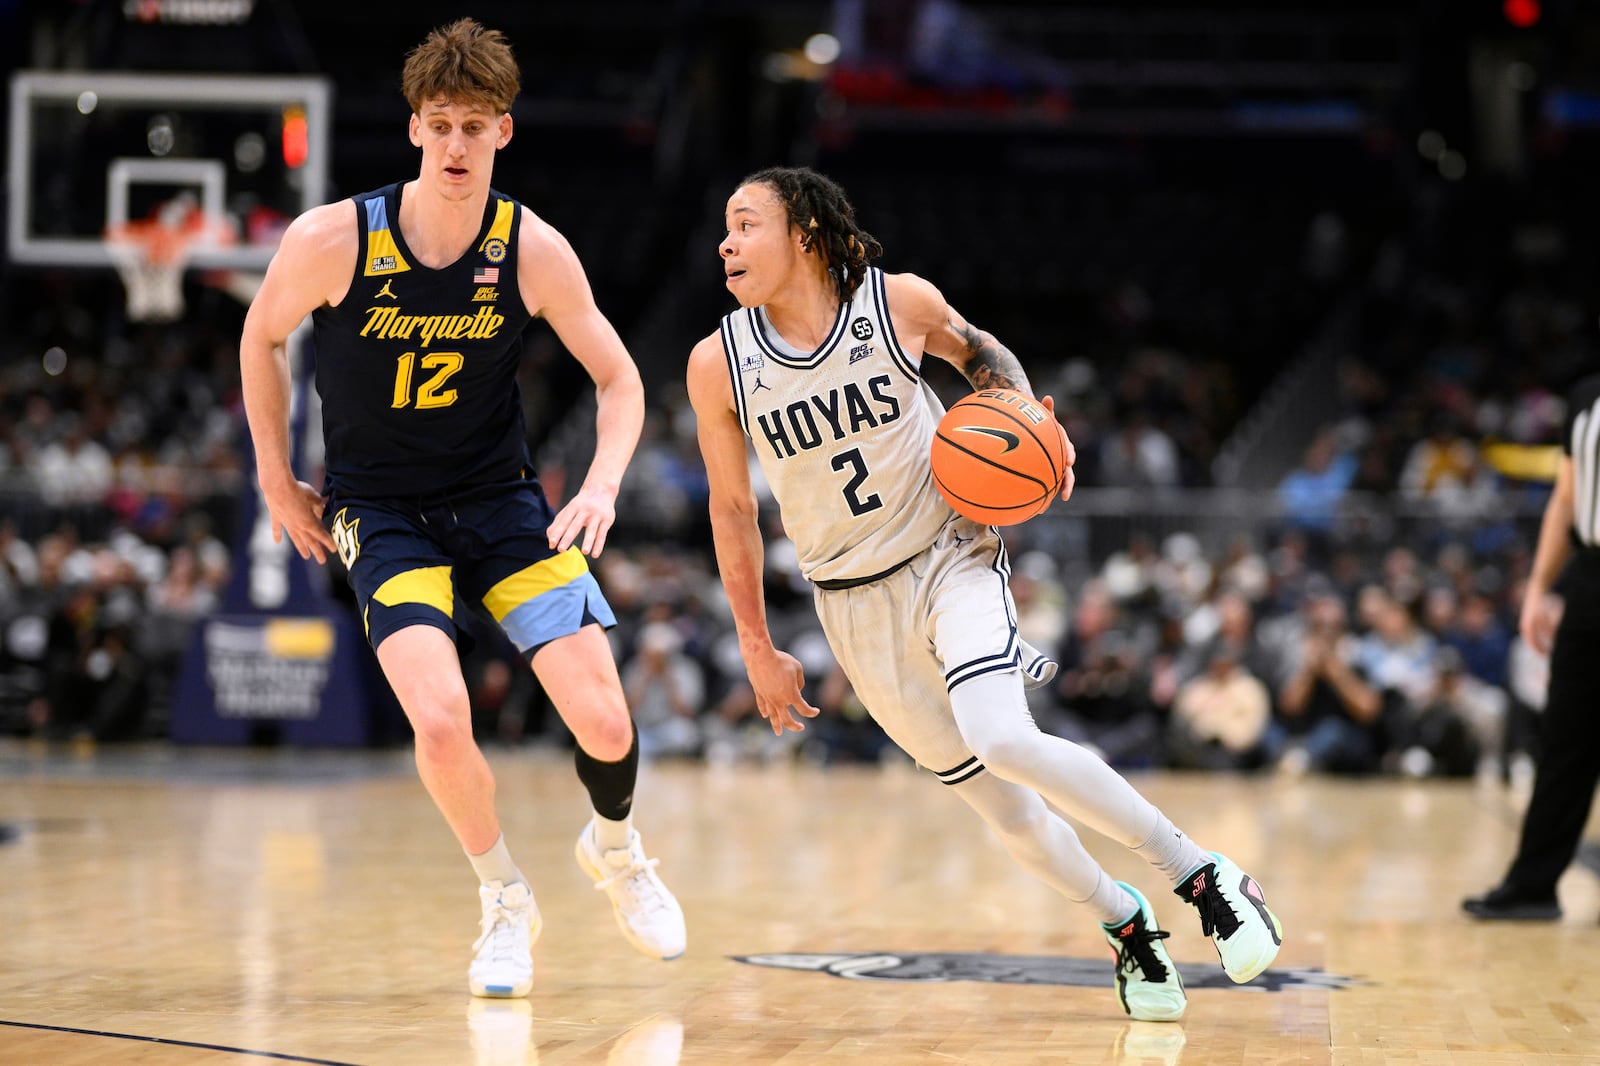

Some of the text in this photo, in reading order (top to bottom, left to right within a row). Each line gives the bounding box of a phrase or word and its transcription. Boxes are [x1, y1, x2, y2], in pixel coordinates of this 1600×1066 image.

[371, 262, 397, 272] CHANGE
[373, 256, 395, 266] BE THE
[359, 305, 505, 348] Marquette
[854, 320, 873, 338] 55
[849, 347, 875, 362] EAST
[850, 343, 868, 355] BIG
[391, 352, 465, 410] 12
[756, 374, 901, 460] HOYAS
[977, 390, 1045, 425] ELITE
[830, 447, 884, 518] 2
